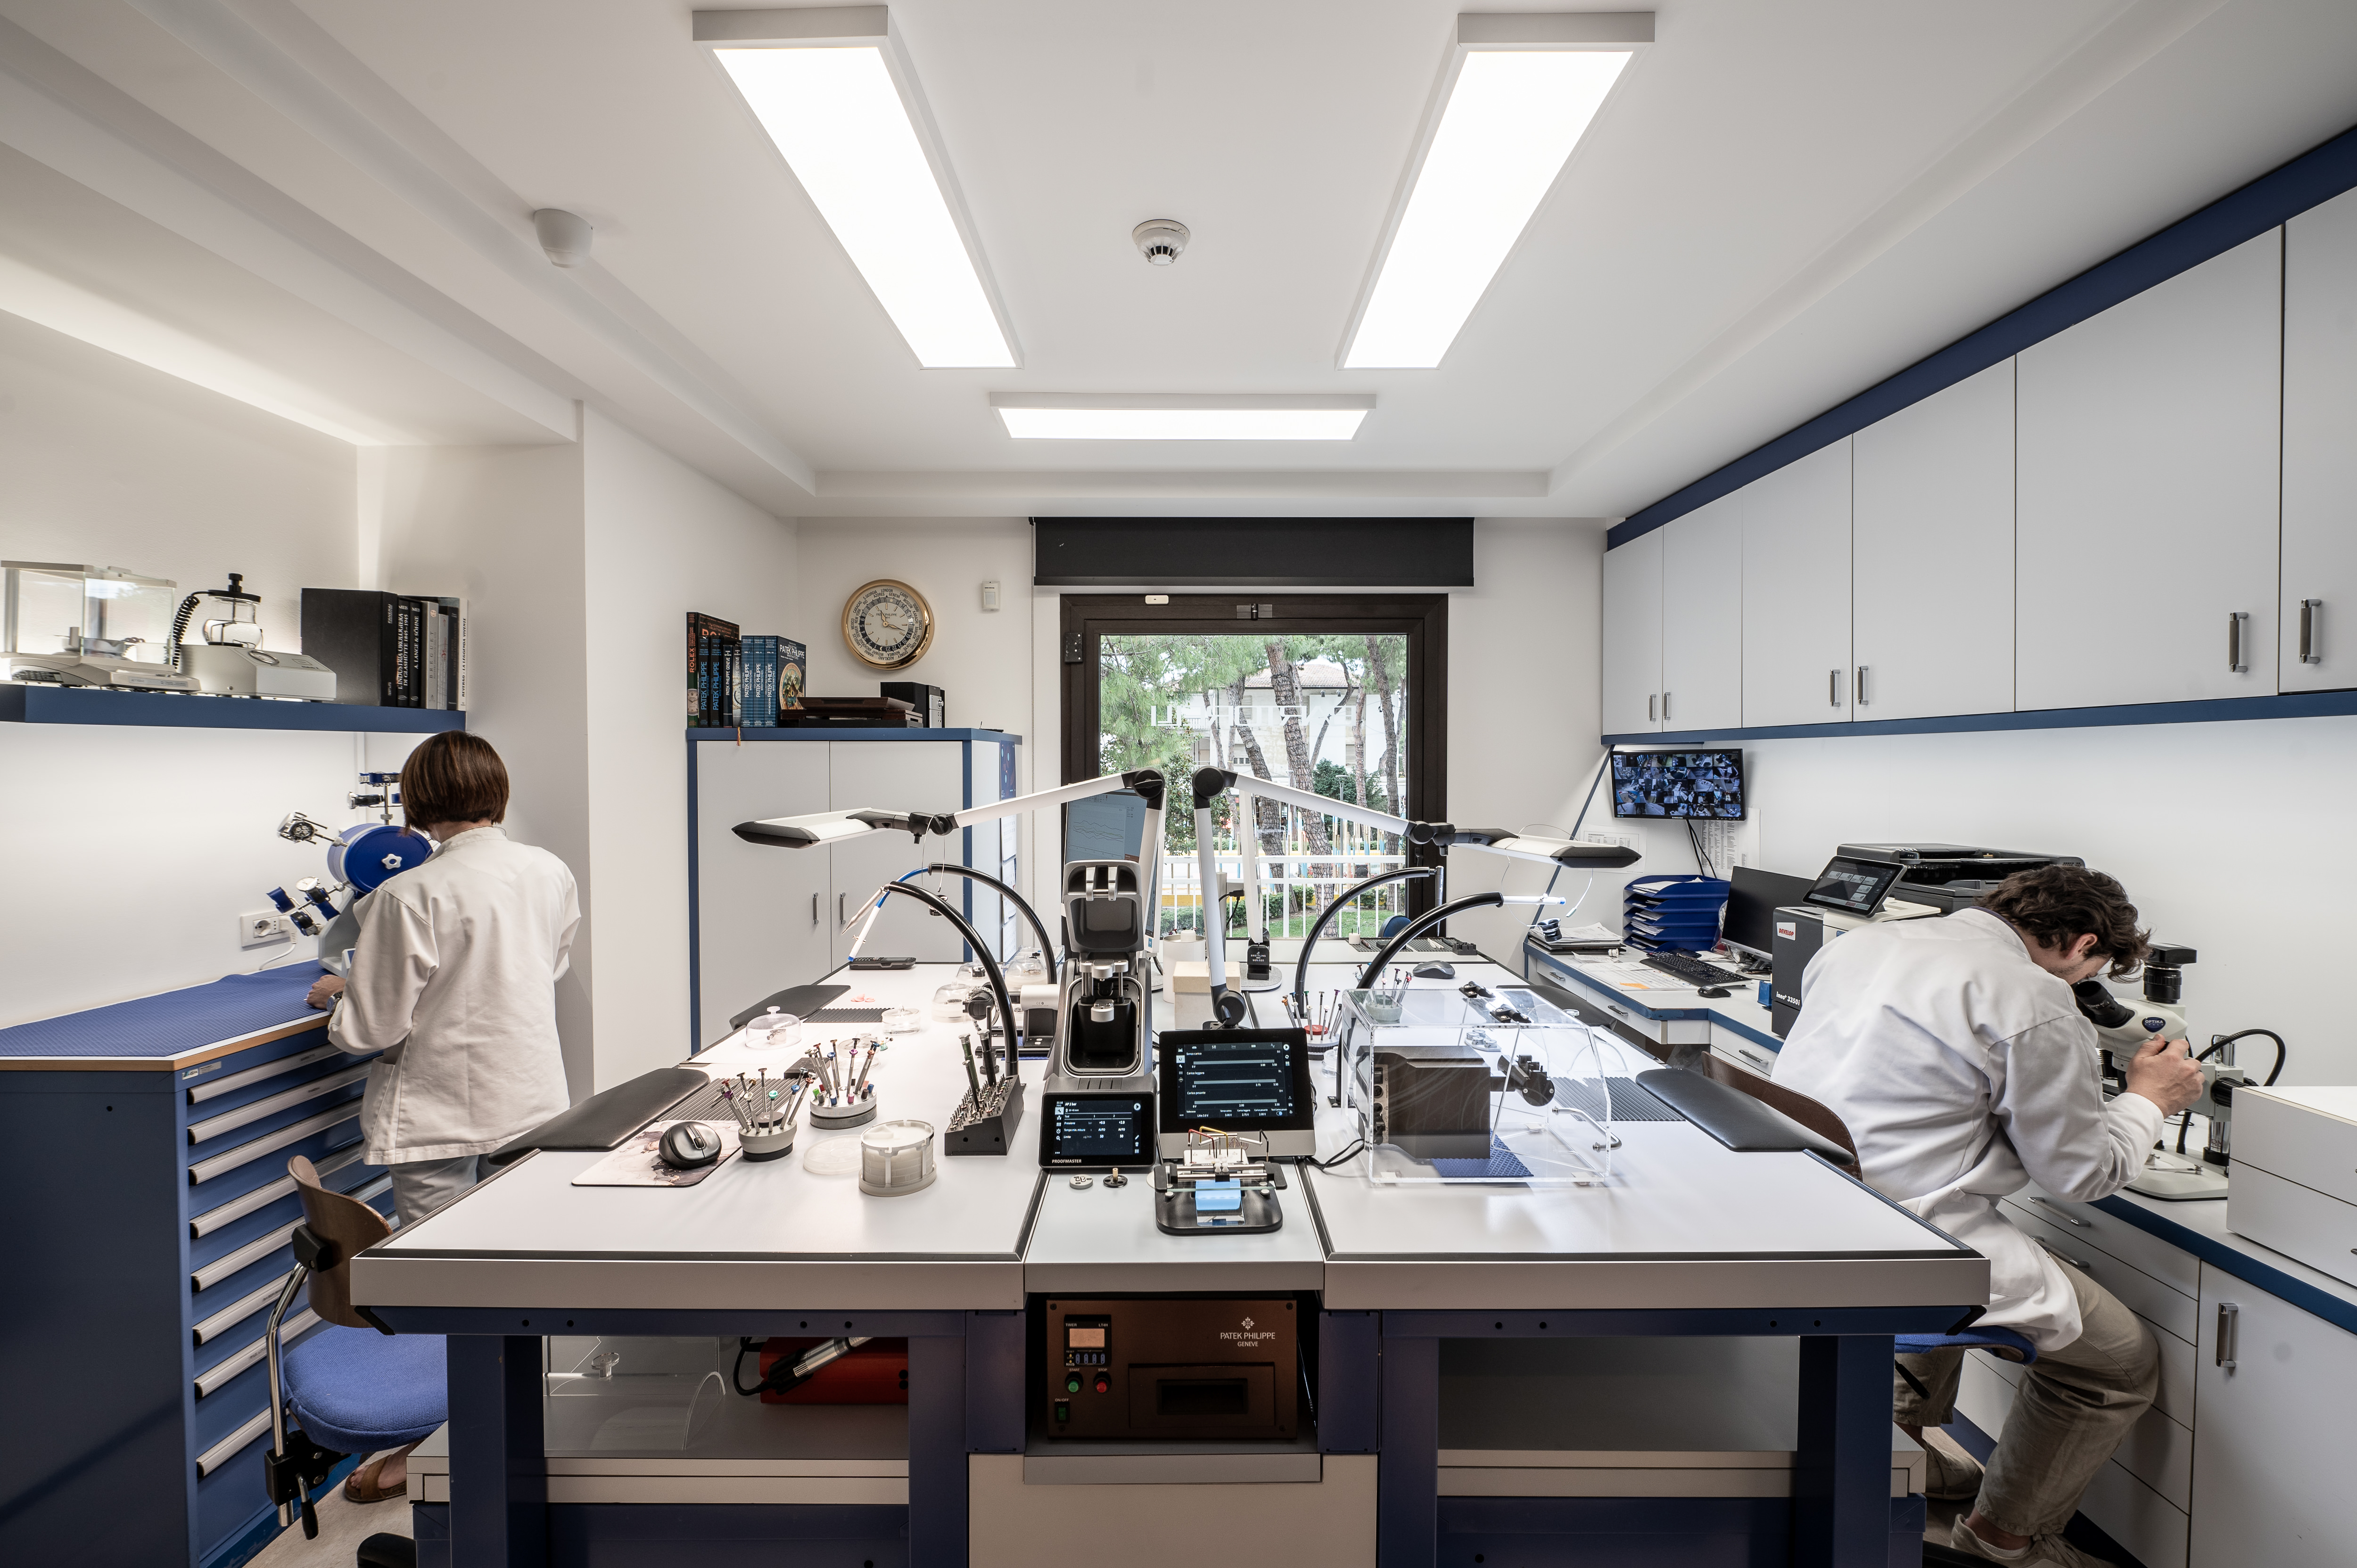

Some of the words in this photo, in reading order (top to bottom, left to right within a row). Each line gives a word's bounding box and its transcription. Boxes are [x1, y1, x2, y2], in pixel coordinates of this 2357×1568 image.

[853, 600, 862, 613] CARACAS
[903, 599, 913, 608] MOSCOW
[780, 644, 791, 655] PATEK
[791, 648, 805, 659] PHILIPPE
[898, 650, 908, 658] SYDNEY
[1779, 928, 1794, 936] DEVELOP
[1787, 996, 1800, 1006] 3350i
